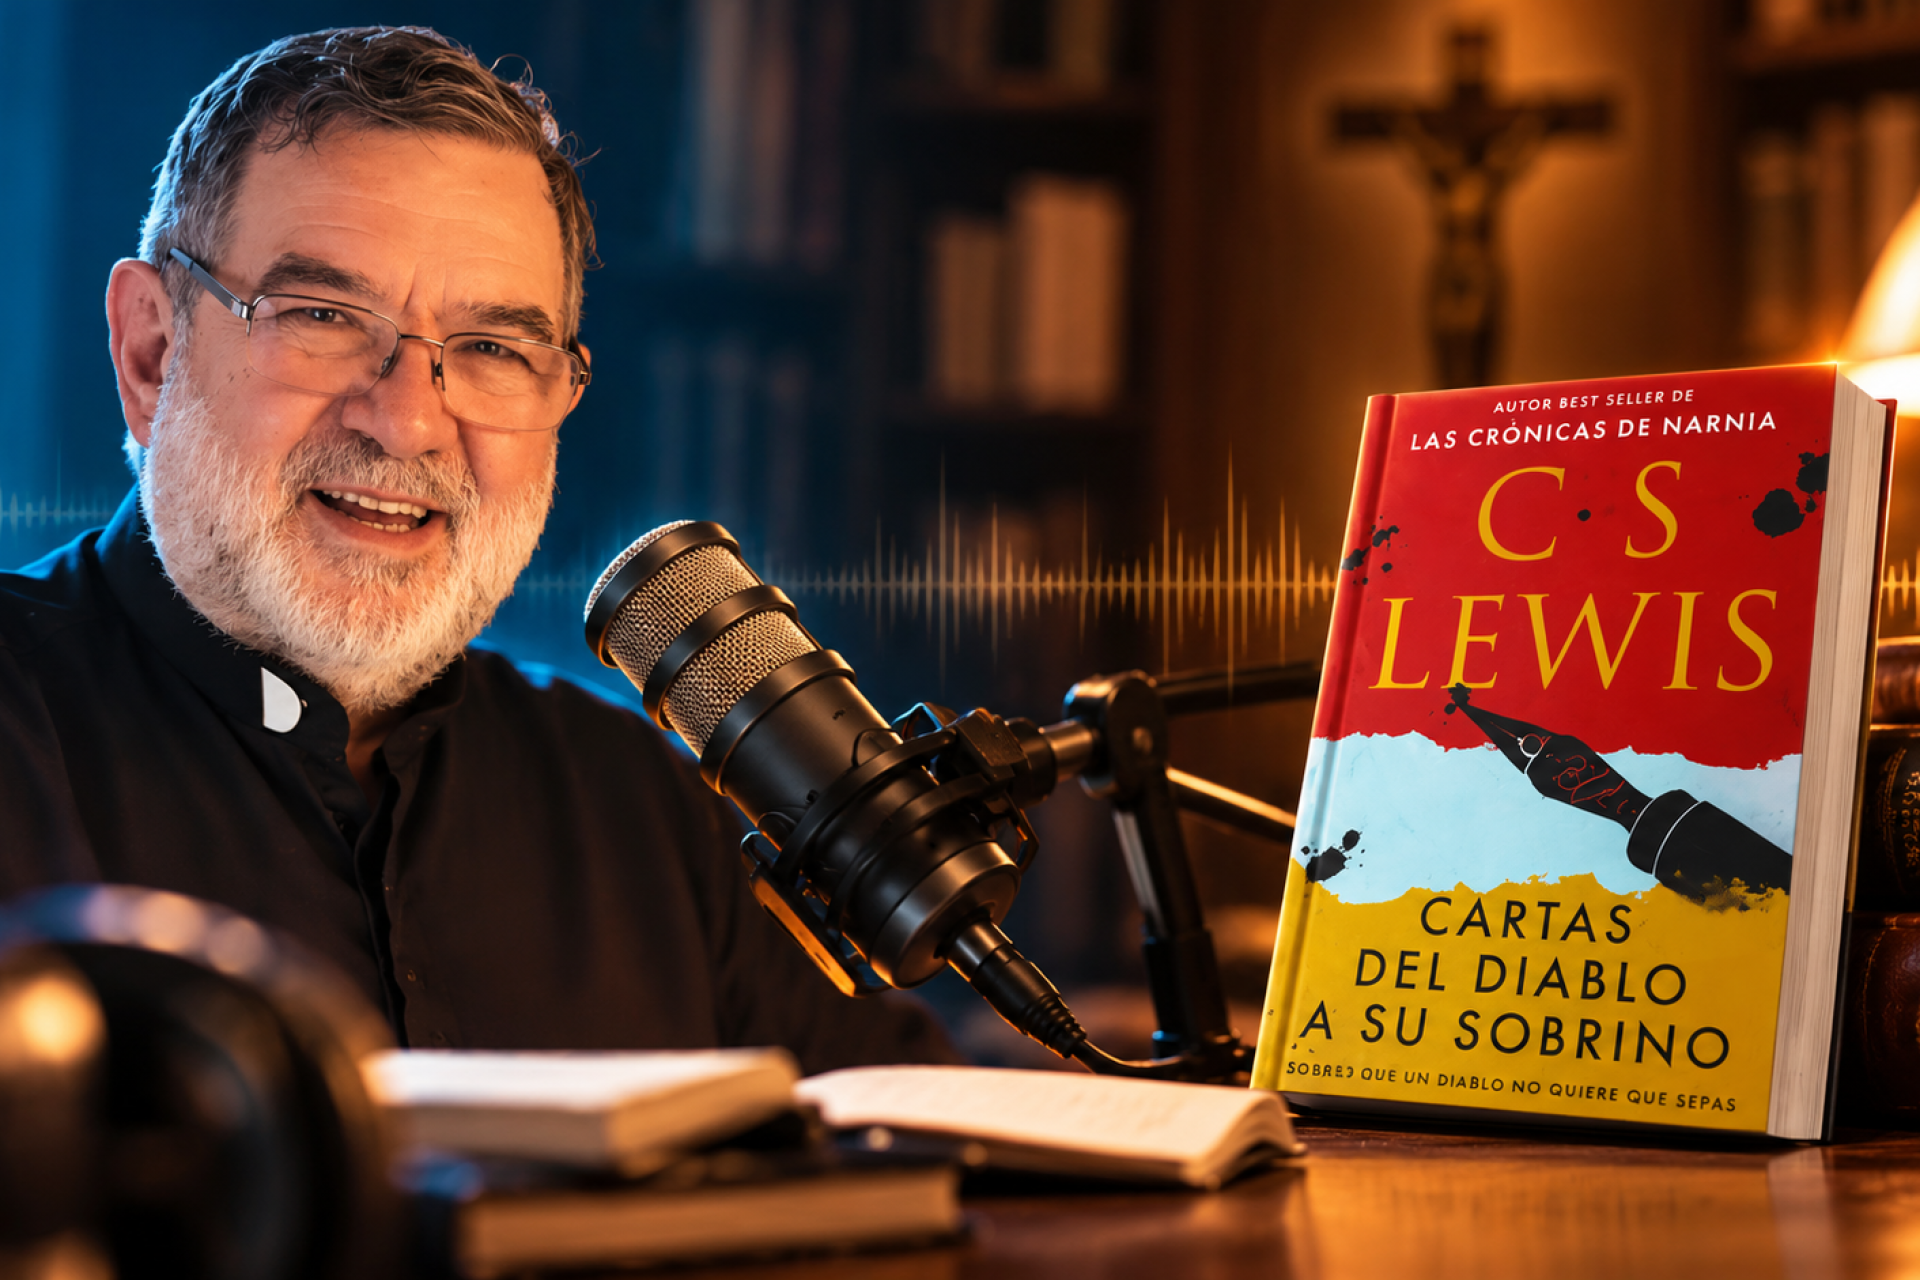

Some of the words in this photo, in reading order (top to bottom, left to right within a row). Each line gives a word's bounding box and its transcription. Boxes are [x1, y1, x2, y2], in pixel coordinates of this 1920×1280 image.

[1493, 399, 1552, 413] AUTOR
[1559, 395, 1599, 409] BEST
[1606, 392, 1664, 406] SELLER
[1672, 389, 1694, 402] DE
[1410, 430, 1457, 451] LAS
[1468, 418, 1607, 448] CRÓNICAS
[1617, 418, 1651, 438] DE
[1662, 411, 1777, 435] NARNIA
[1624, 460, 1682, 559] S
[1368, 588, 1778, 692] LEWIS
[1420, 896, 1632, 945] CARTAS
[1355, 948, 1446, 992] DEL
[1474, 954, 1687, 1007] DIABLO
[1299, 1000, 1333, 1040] A
[1360, 1003, 1428, 1047] SU
[1454, 1009, 1730, 1071] SOBRINO
[1360, 1067, 1397, 1083] QUE
[1404, 1071, 1429, 1085] UN
[1437, 1073, 1504, 1093] DIABLO
[1511, 1080, 1541, 1096] NO
[1549, 1083, 1618, 1102] QUIERE
[1627, 1089, 1667, 1107] QUE
[1676, 1094, 1737, 1113] SEPAS
